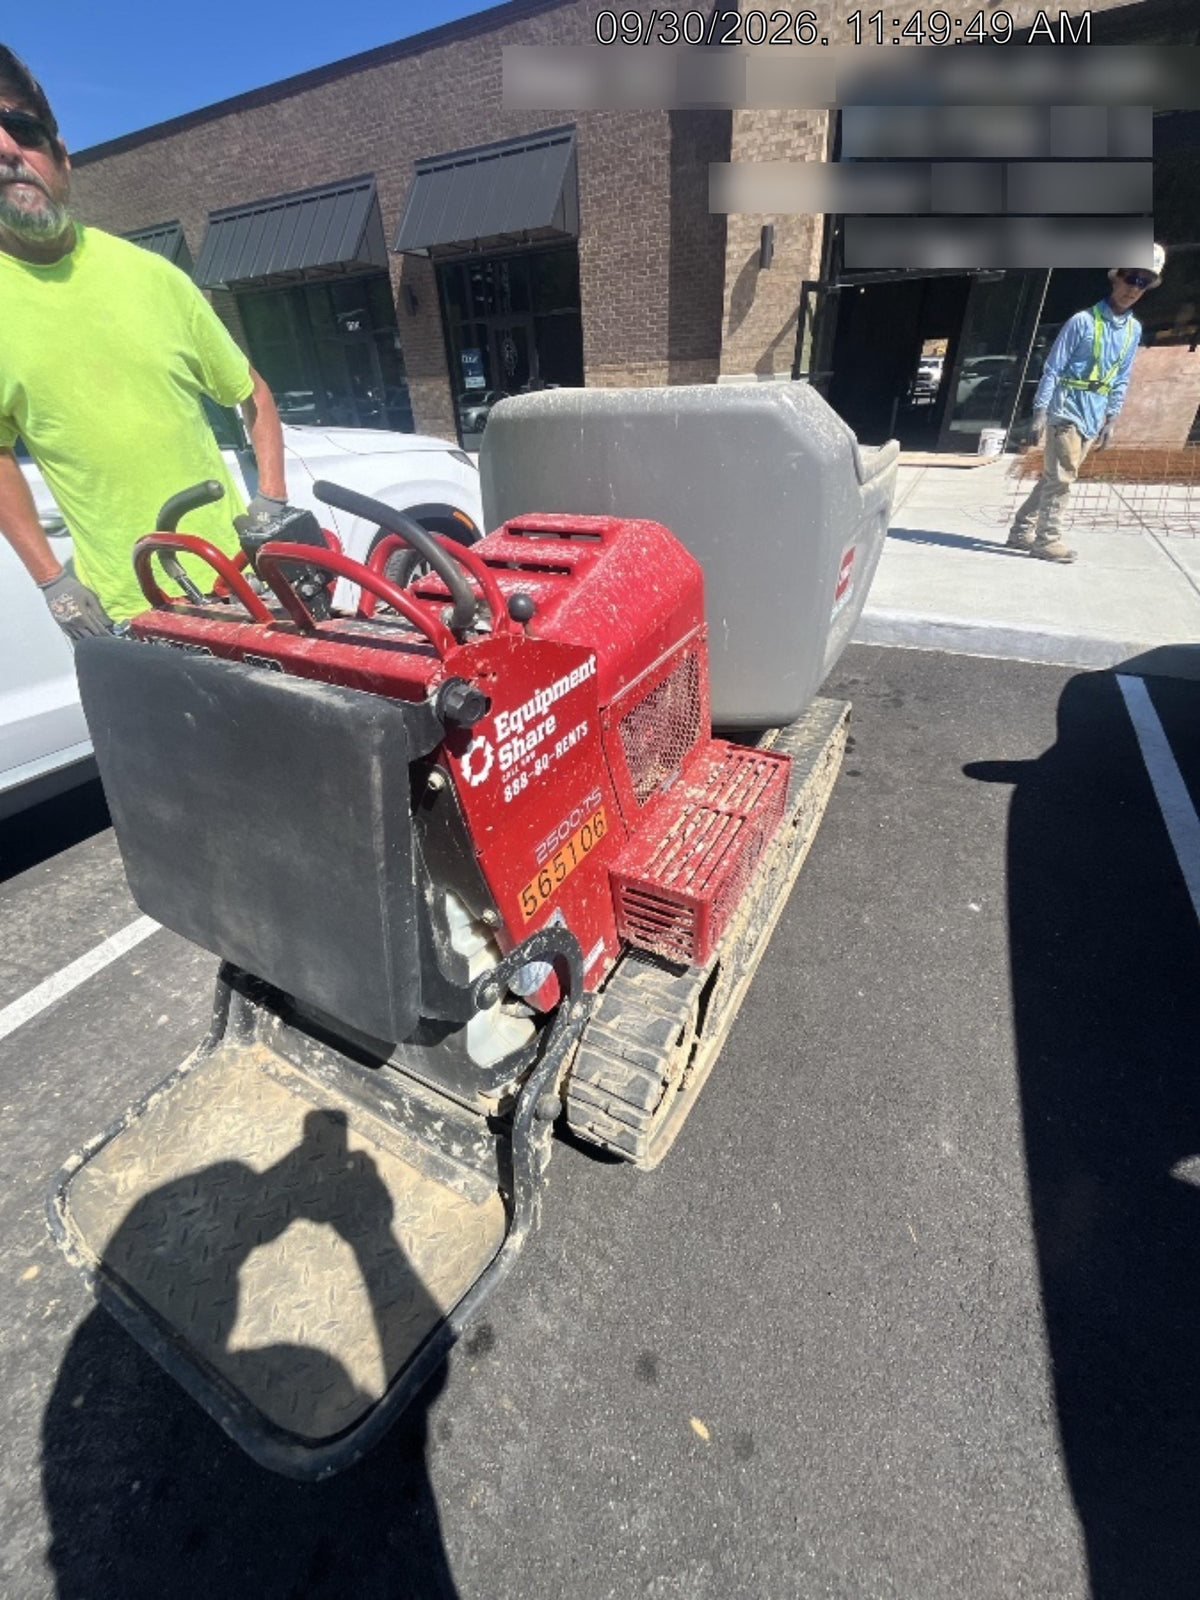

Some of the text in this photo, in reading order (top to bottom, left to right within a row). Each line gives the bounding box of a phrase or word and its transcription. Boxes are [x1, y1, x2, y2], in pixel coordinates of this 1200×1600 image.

[493, 653, 597, 743] Equipment
[498, 714, 557, 771] Share
[522, 811, 605, 917] 565106
